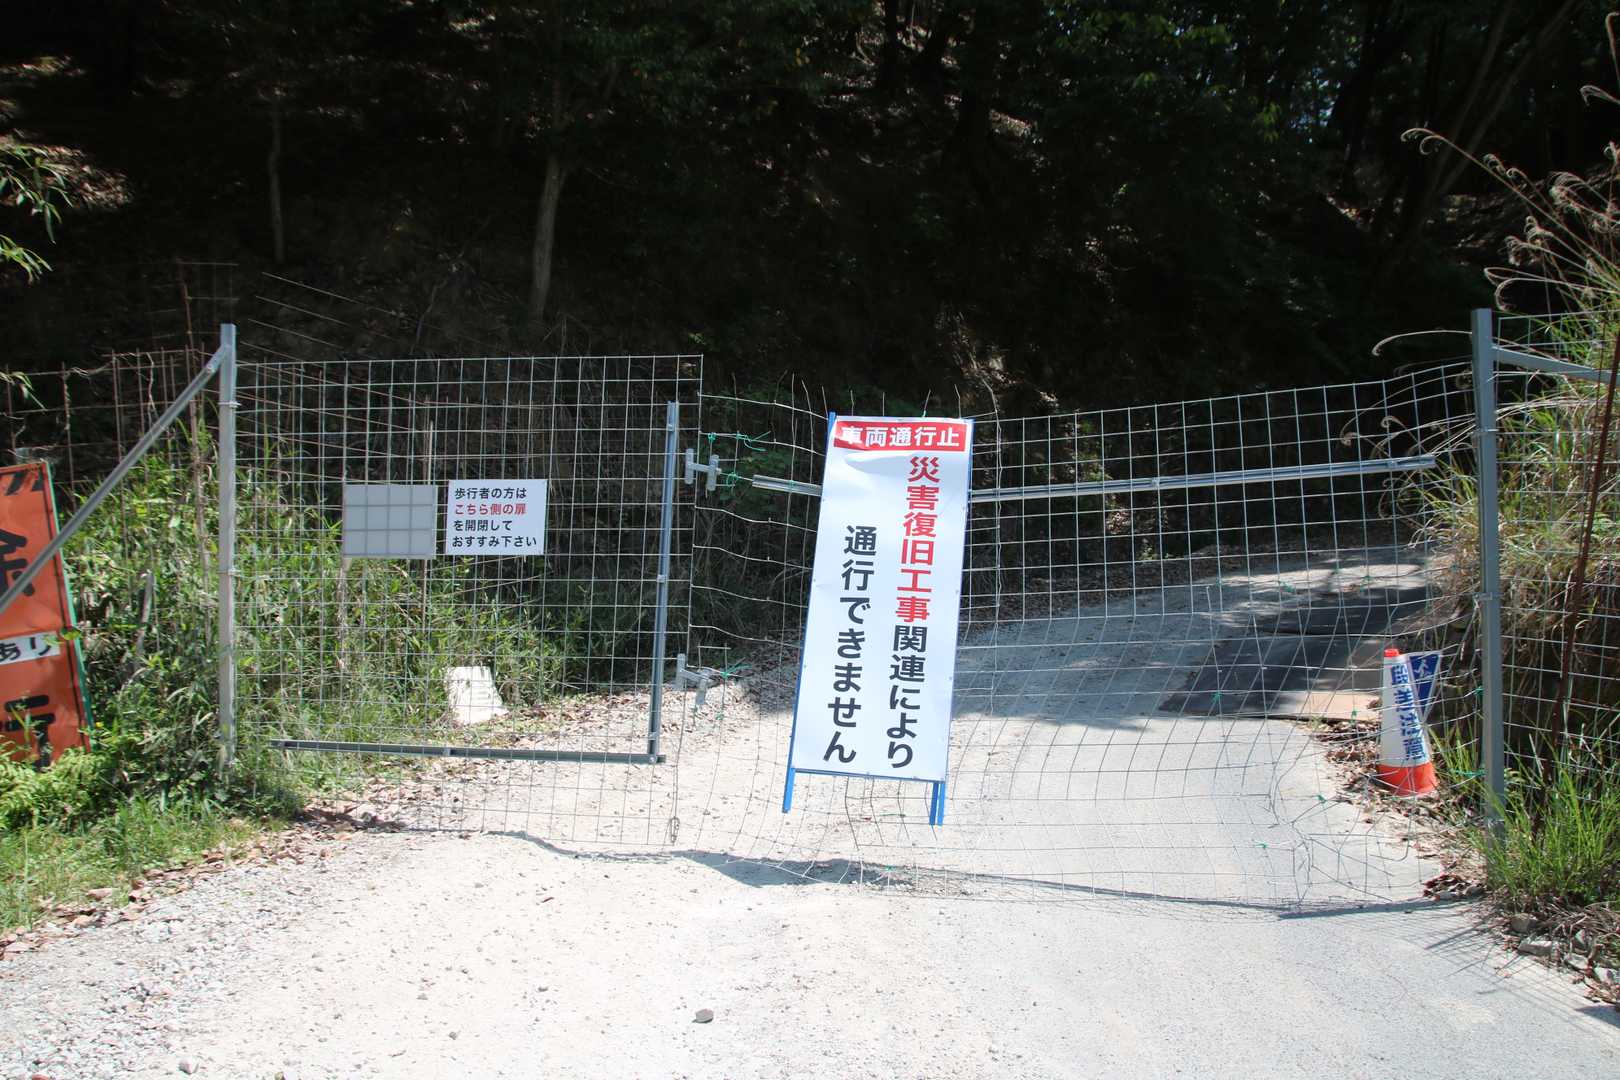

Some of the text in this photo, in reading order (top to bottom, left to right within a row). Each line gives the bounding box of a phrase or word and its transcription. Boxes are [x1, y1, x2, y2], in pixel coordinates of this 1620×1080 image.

[840, 425, 960, 447] 車両通行止
[454, 487, 527, 499] 歩行者の方は
[454, 503, 527, 515] こちら側の扉
[453, 519, 513, 531] を開閉して
[452, 535, 537, 548] おすすみ下さい
[886, 456, 941, 768] 災害復旧工事関連により
[823, 525, 877, 763] 通行できません
